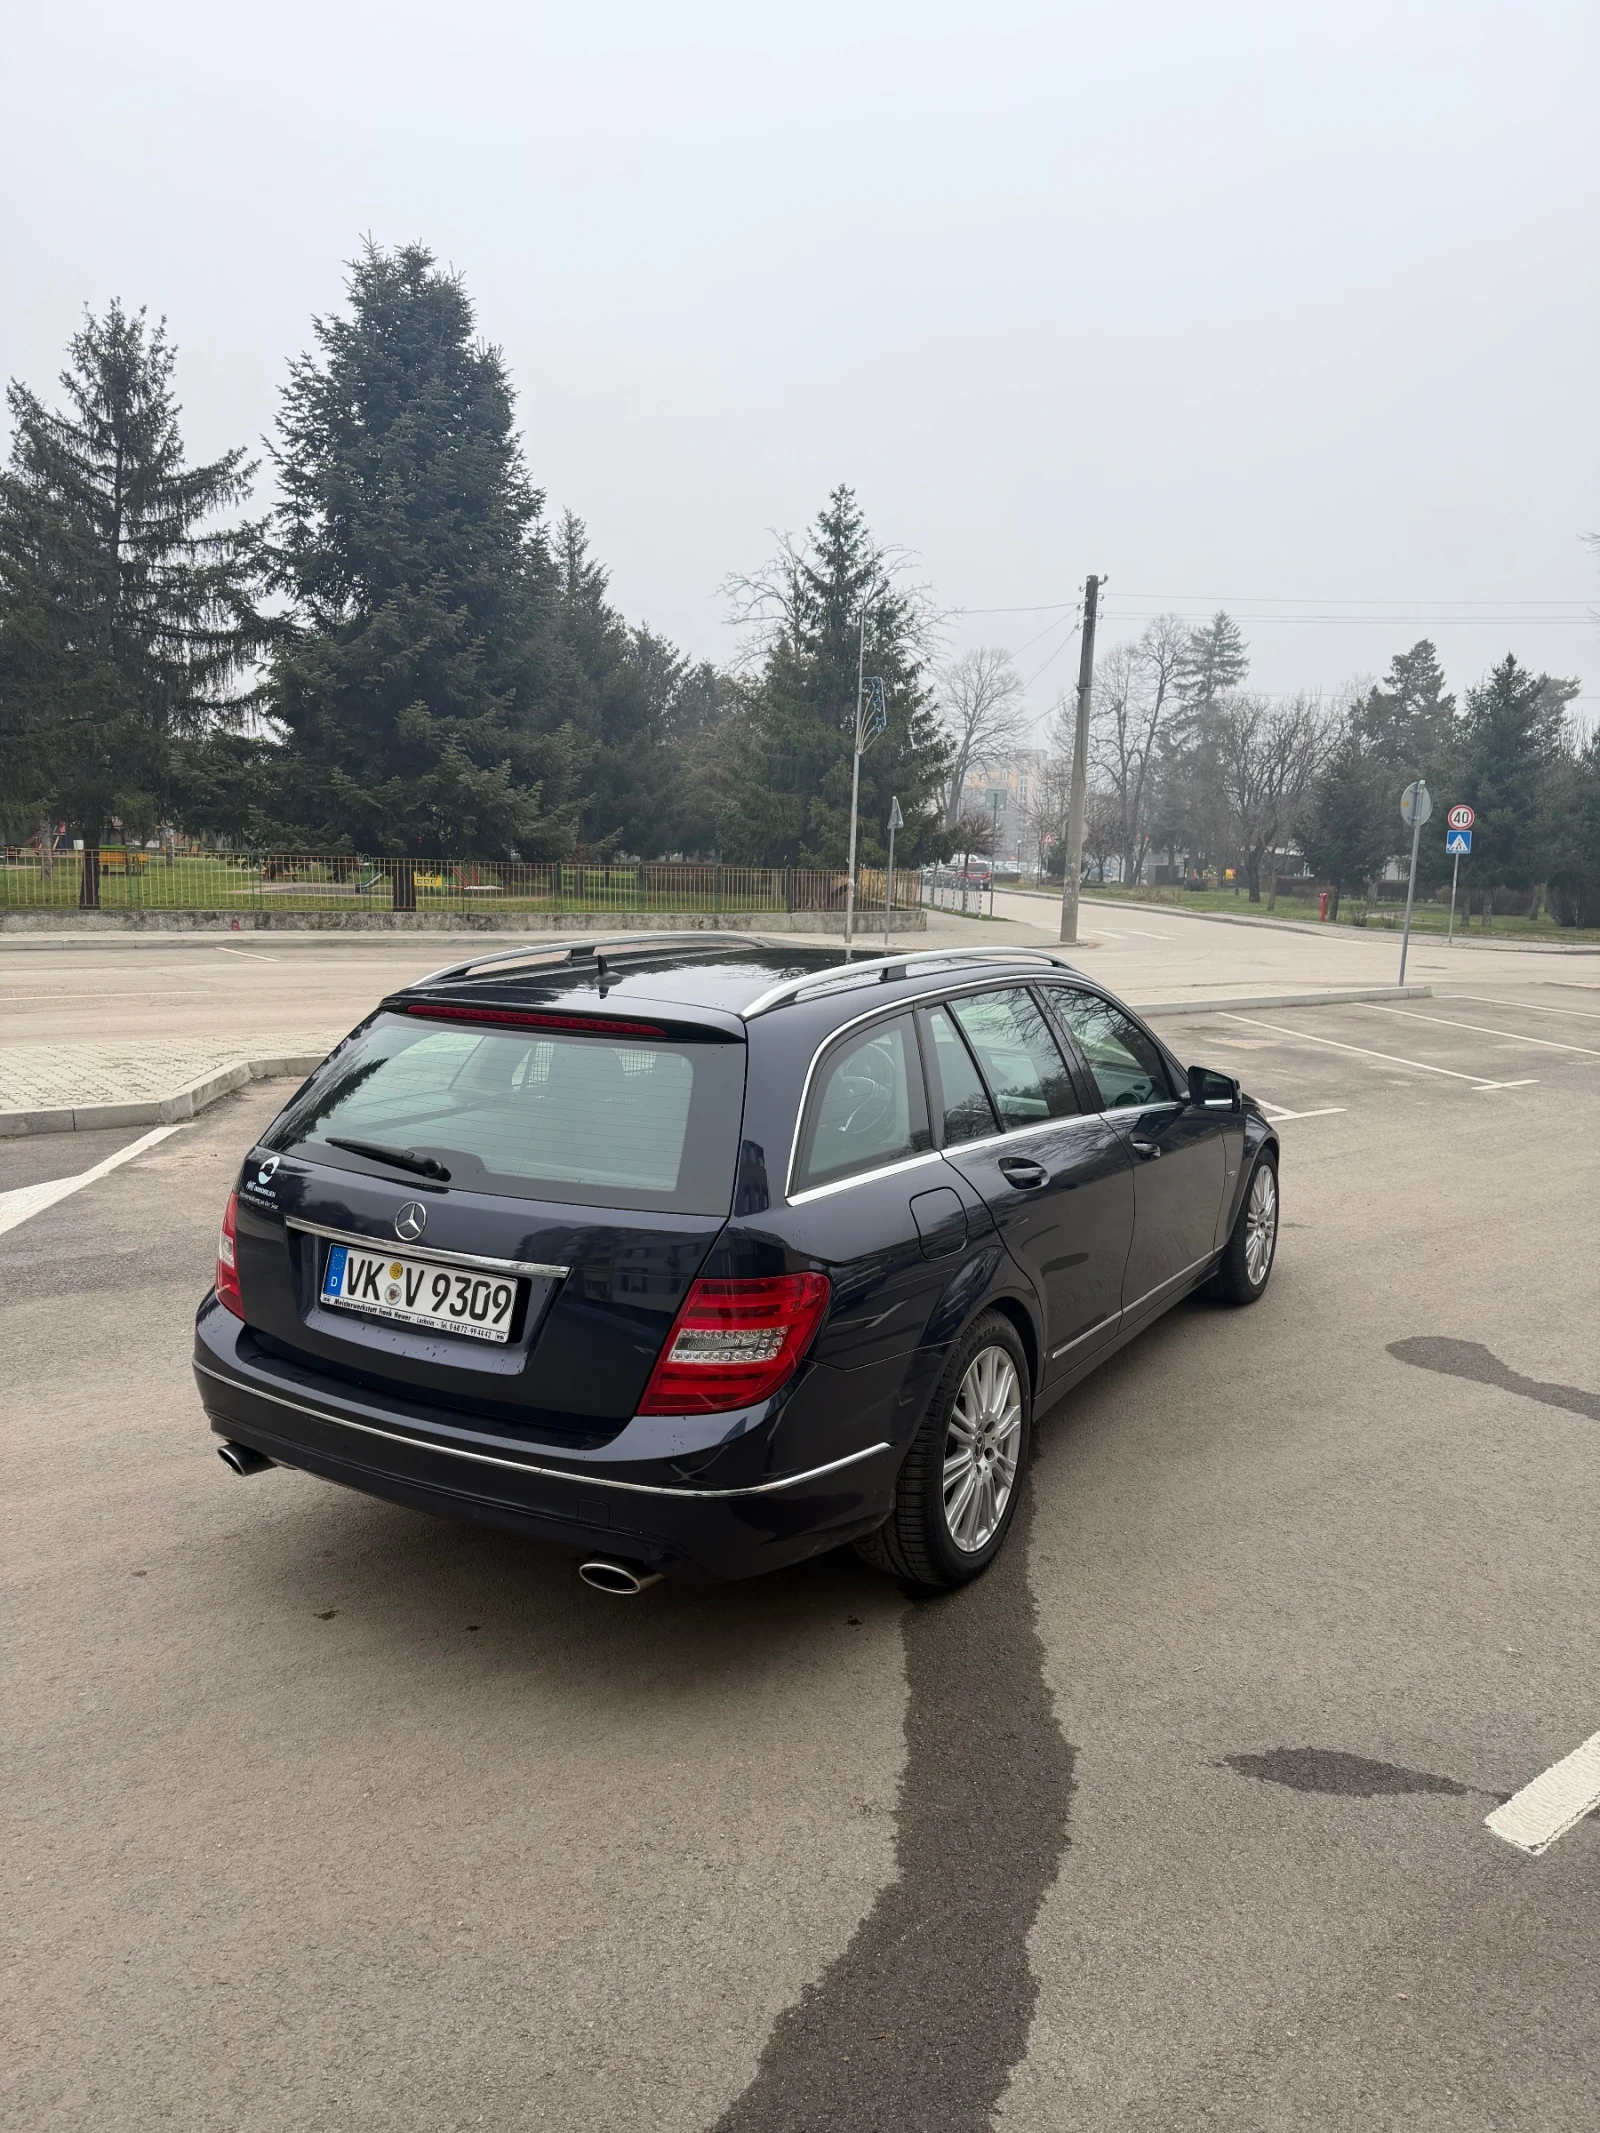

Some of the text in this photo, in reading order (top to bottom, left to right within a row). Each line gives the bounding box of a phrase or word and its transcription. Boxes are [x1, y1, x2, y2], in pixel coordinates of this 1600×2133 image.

[1453, 811, 1470, 824] 40
[330, 1276, 338, 1288] D
[347, 1257, 513, 1324] VK V 9309
